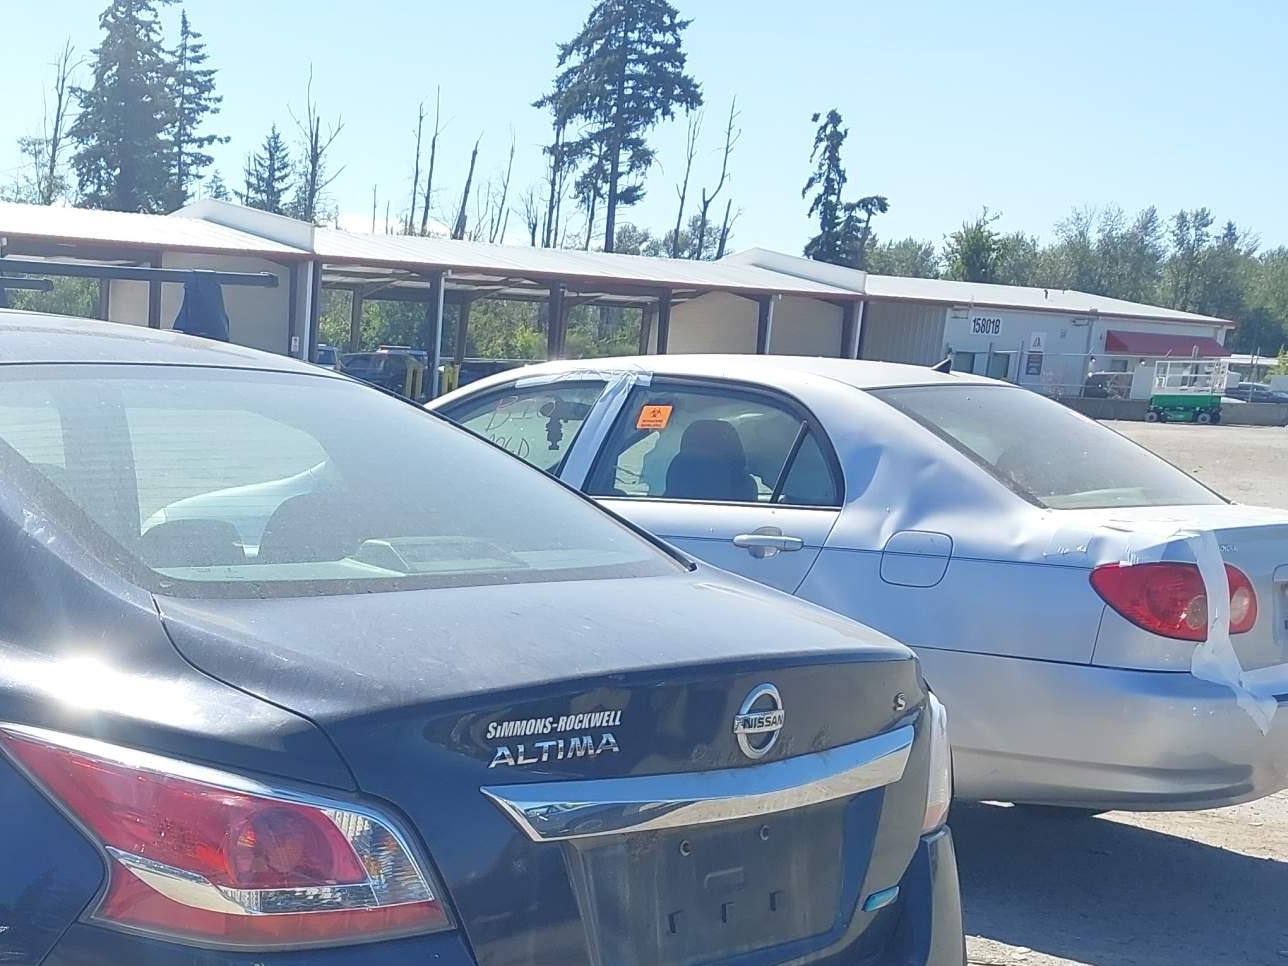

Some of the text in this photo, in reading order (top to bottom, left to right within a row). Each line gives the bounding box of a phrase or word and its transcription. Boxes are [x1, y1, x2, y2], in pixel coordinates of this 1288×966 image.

[972, 318, 1000, 334] 15801B
[893, 693, 906, 711] S
[742, 711, 784, 730] NISSAN
[488, 732, 620, 768] ALTIMA
